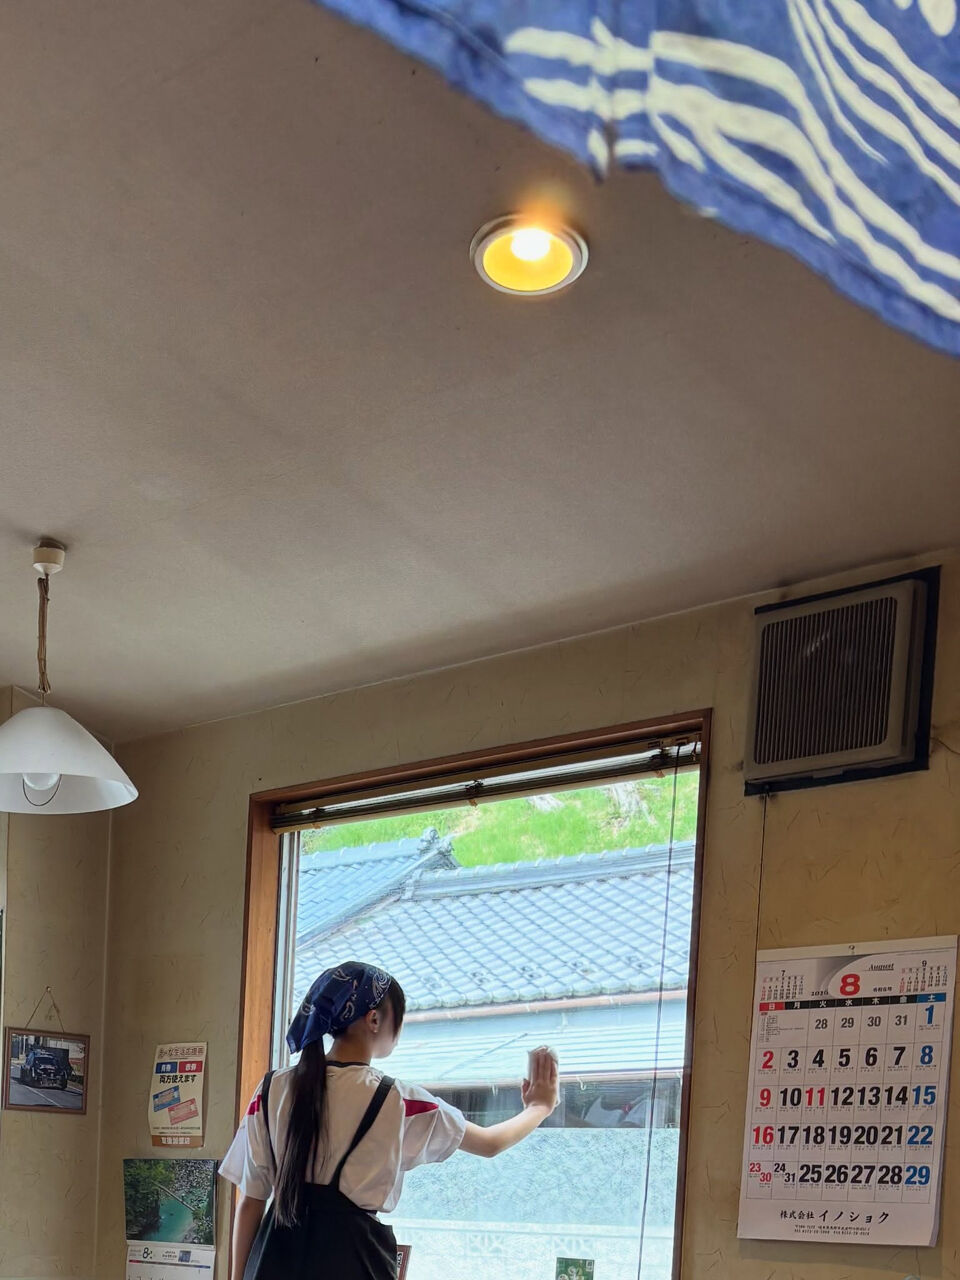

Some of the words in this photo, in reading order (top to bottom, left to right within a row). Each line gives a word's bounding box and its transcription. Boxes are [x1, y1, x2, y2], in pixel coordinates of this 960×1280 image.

[839, 973, 860, 997] 8
[793, 1001, 801, 1009] 月
[819, 1000, 827, 1008] 火
[845, 998, 853, 1007] 水
[871, 997, 880, 1006] 木
[927, 994, 936, 1003] 土
[815, 1019, 828, 1030] 28
[841, 1017, 855, 1028] 29
[867, 1016, 881, 1027] 30
[895, 1014, 908, 1026] 31
[925, 1005, 935, 1024] 1
[762, 1051, 773, 1069] 2
[787, 1050, 799, 1068] 3
[812, 1049, 824, 1067] 4
[838, 1048, 851, 1067] 5
[865, 1047, 877, 1066] 6
[893, 1047, 906, 1065] 7
[920, 1045, 934, 1065] 8
[159, 1074, 198, 1085] 両方使えます
[759, 1088, 771, 1107] 9
[779, 1087, 802, 1106] 10
[805, 1087, 825, 1106] 11
[831, 1087, 854, 1106] 12
[857, 1086, 881, 1105] 13
[884, 1086, 908, 1105] 14
[912, 1085, 936, 1105] 15
[752, 1125, 774, 1144] 16
[777, 1125, 799, 1144] 17
[803, 1125, 825, 1144] 18
[828, 1125, 851, 1144] 19
[854, 1125, 879, 1145] 20
[881, 1125, 903, 1145] 21
[907, 1125, 933, 1145] 22
[750, 1163, 760, 1173] 23
[774, 1163, 786, 1173] 24
[799, 1164, 822, 1183] 25
[824, 1164, 849, 1183] 26
[851, 1165, 875, 1184] 27
[878, 1165, 902, 1185] 28
[905, 1166, 930, 1185] 29
[759, 1172, 771, 1182] 30
[784, 1173, 796, 1183] 31
[819, 1209, 890, 1225] イノショク
[142, 1247, 150, 1259] 8
